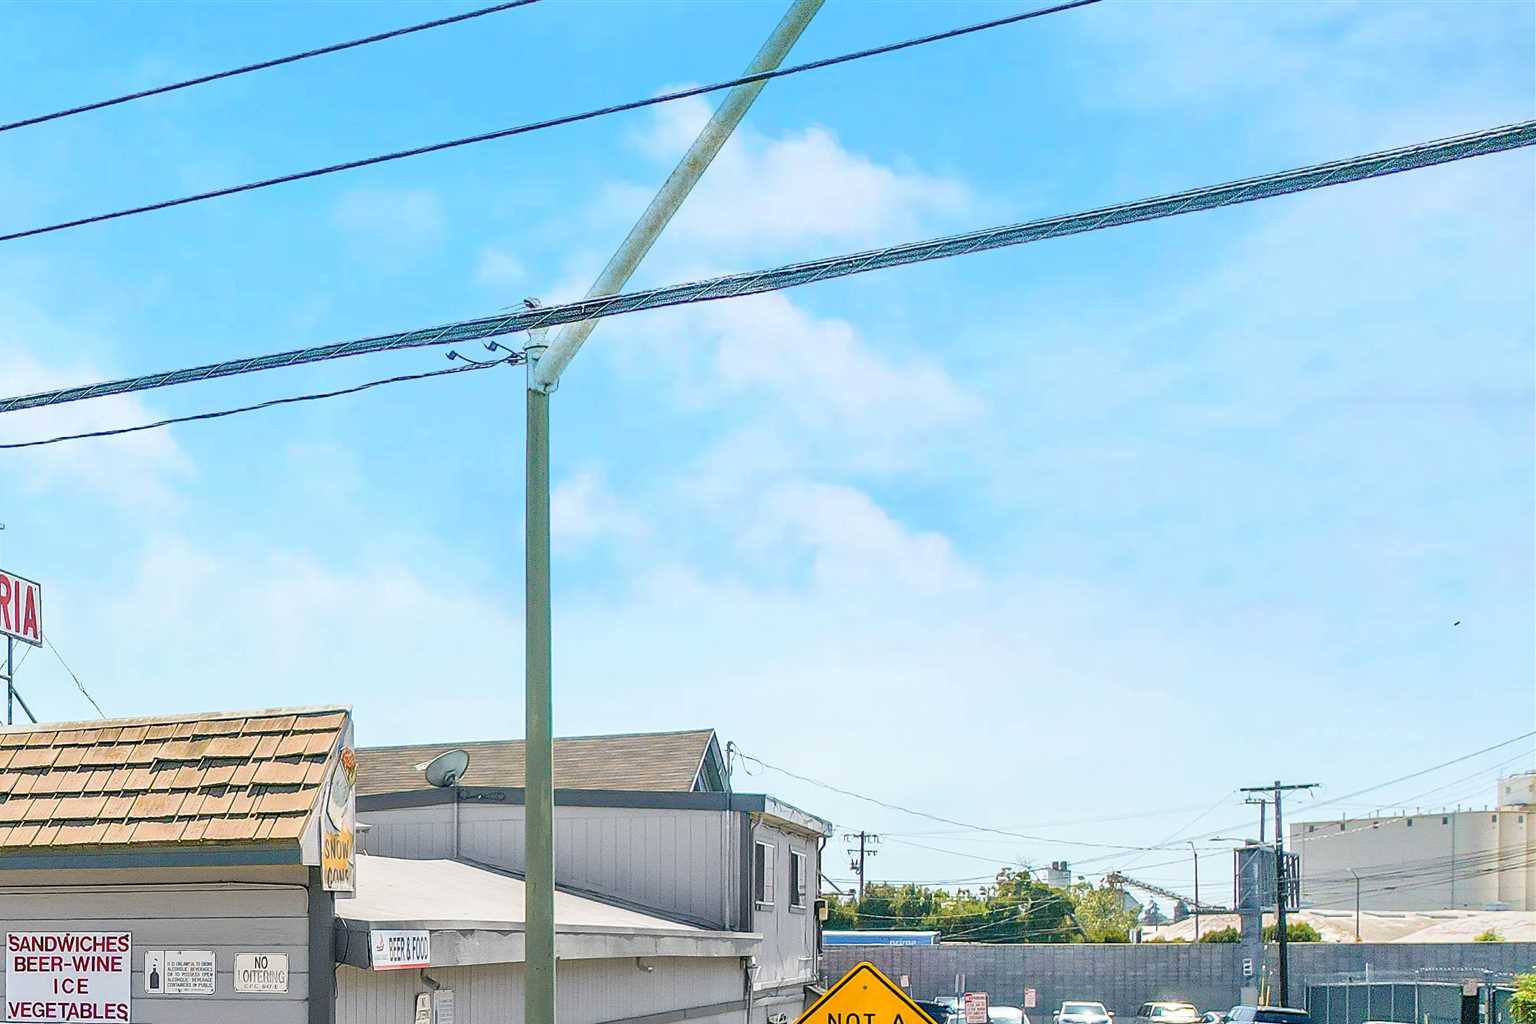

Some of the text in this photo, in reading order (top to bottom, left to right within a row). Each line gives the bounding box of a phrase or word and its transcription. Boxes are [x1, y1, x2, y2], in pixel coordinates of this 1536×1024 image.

[8, 935, 130, 952] SANDWICHES
[389, 936, 428, 961] BEER & FOOD
[14, 955, 123, 972] BEER-WINE
[254, 956, 268, 969] NO
[238, 969, 285, 983] OITERING
[53, 978, 89, 994] ICE
[8, 1002, 128, 1020] VEGETABLES
